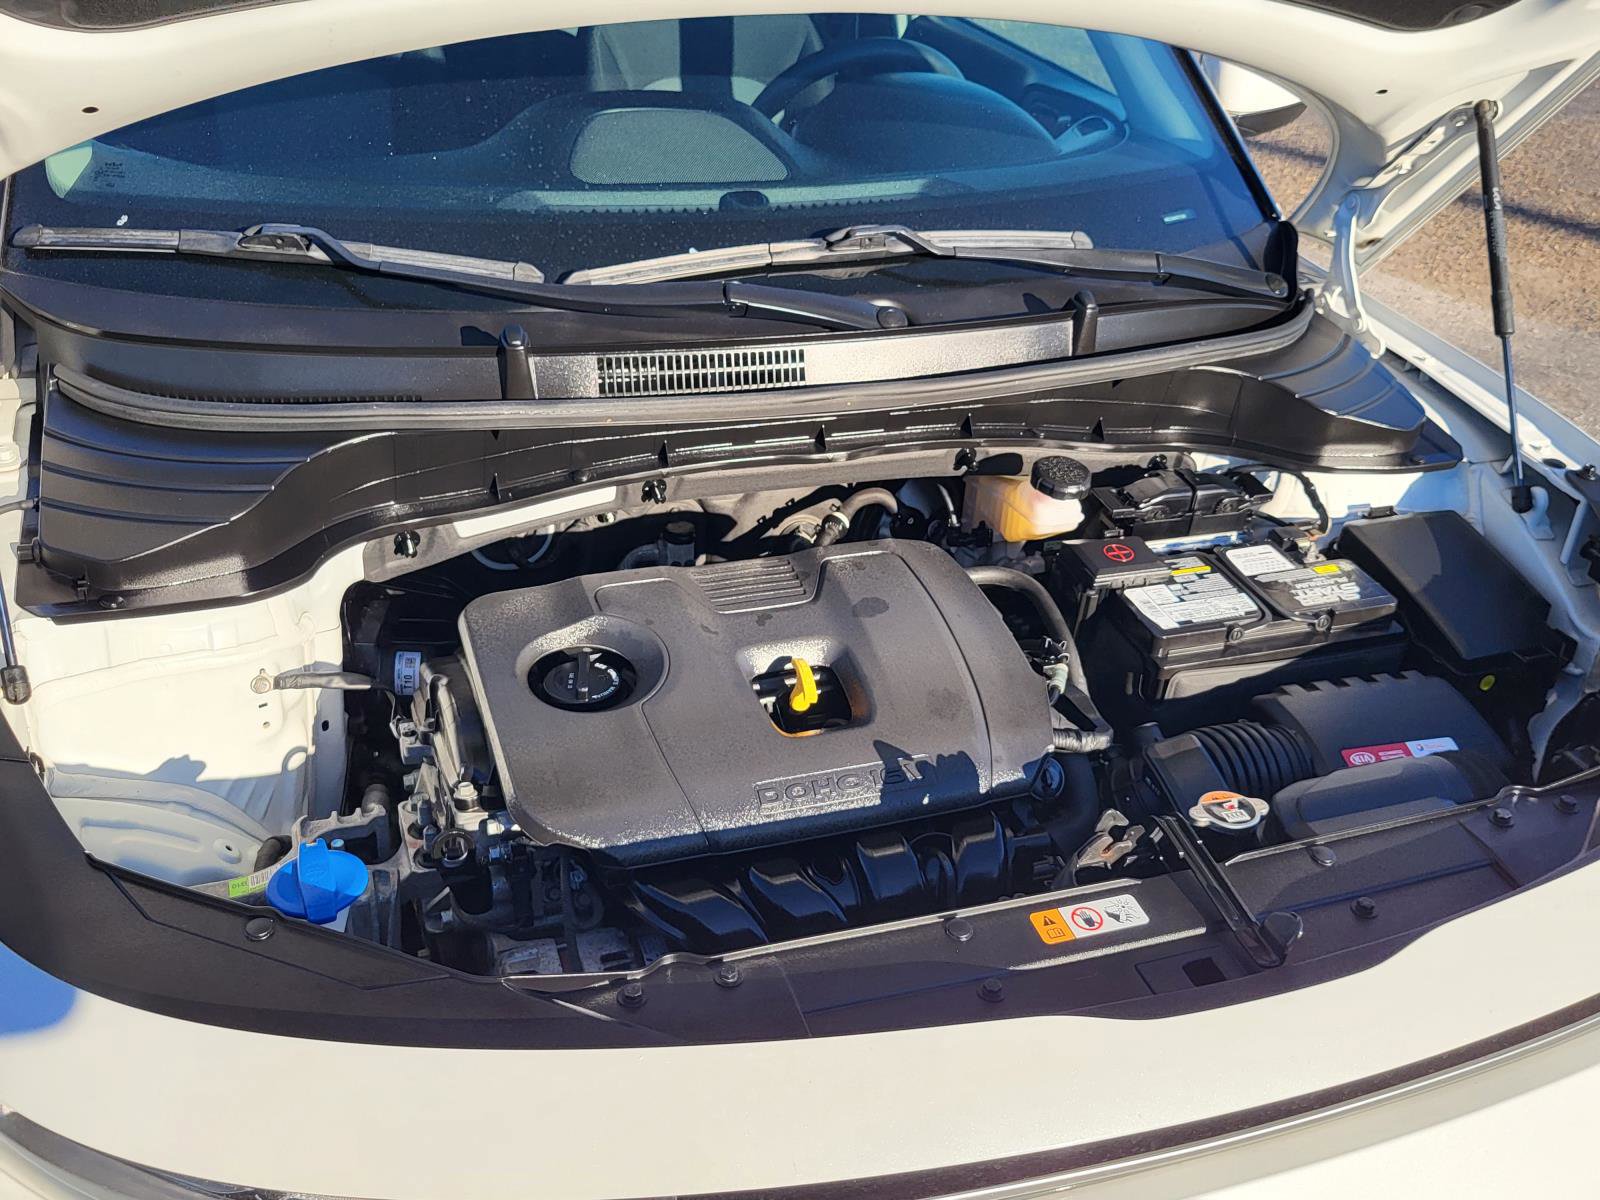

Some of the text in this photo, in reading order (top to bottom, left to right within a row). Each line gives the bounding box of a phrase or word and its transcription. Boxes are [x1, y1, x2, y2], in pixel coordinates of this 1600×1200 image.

[403, 674, 413, 689] T10
[1351, 753, 1374, 764] KIA
[756, 772, 862, 806] DOHC
